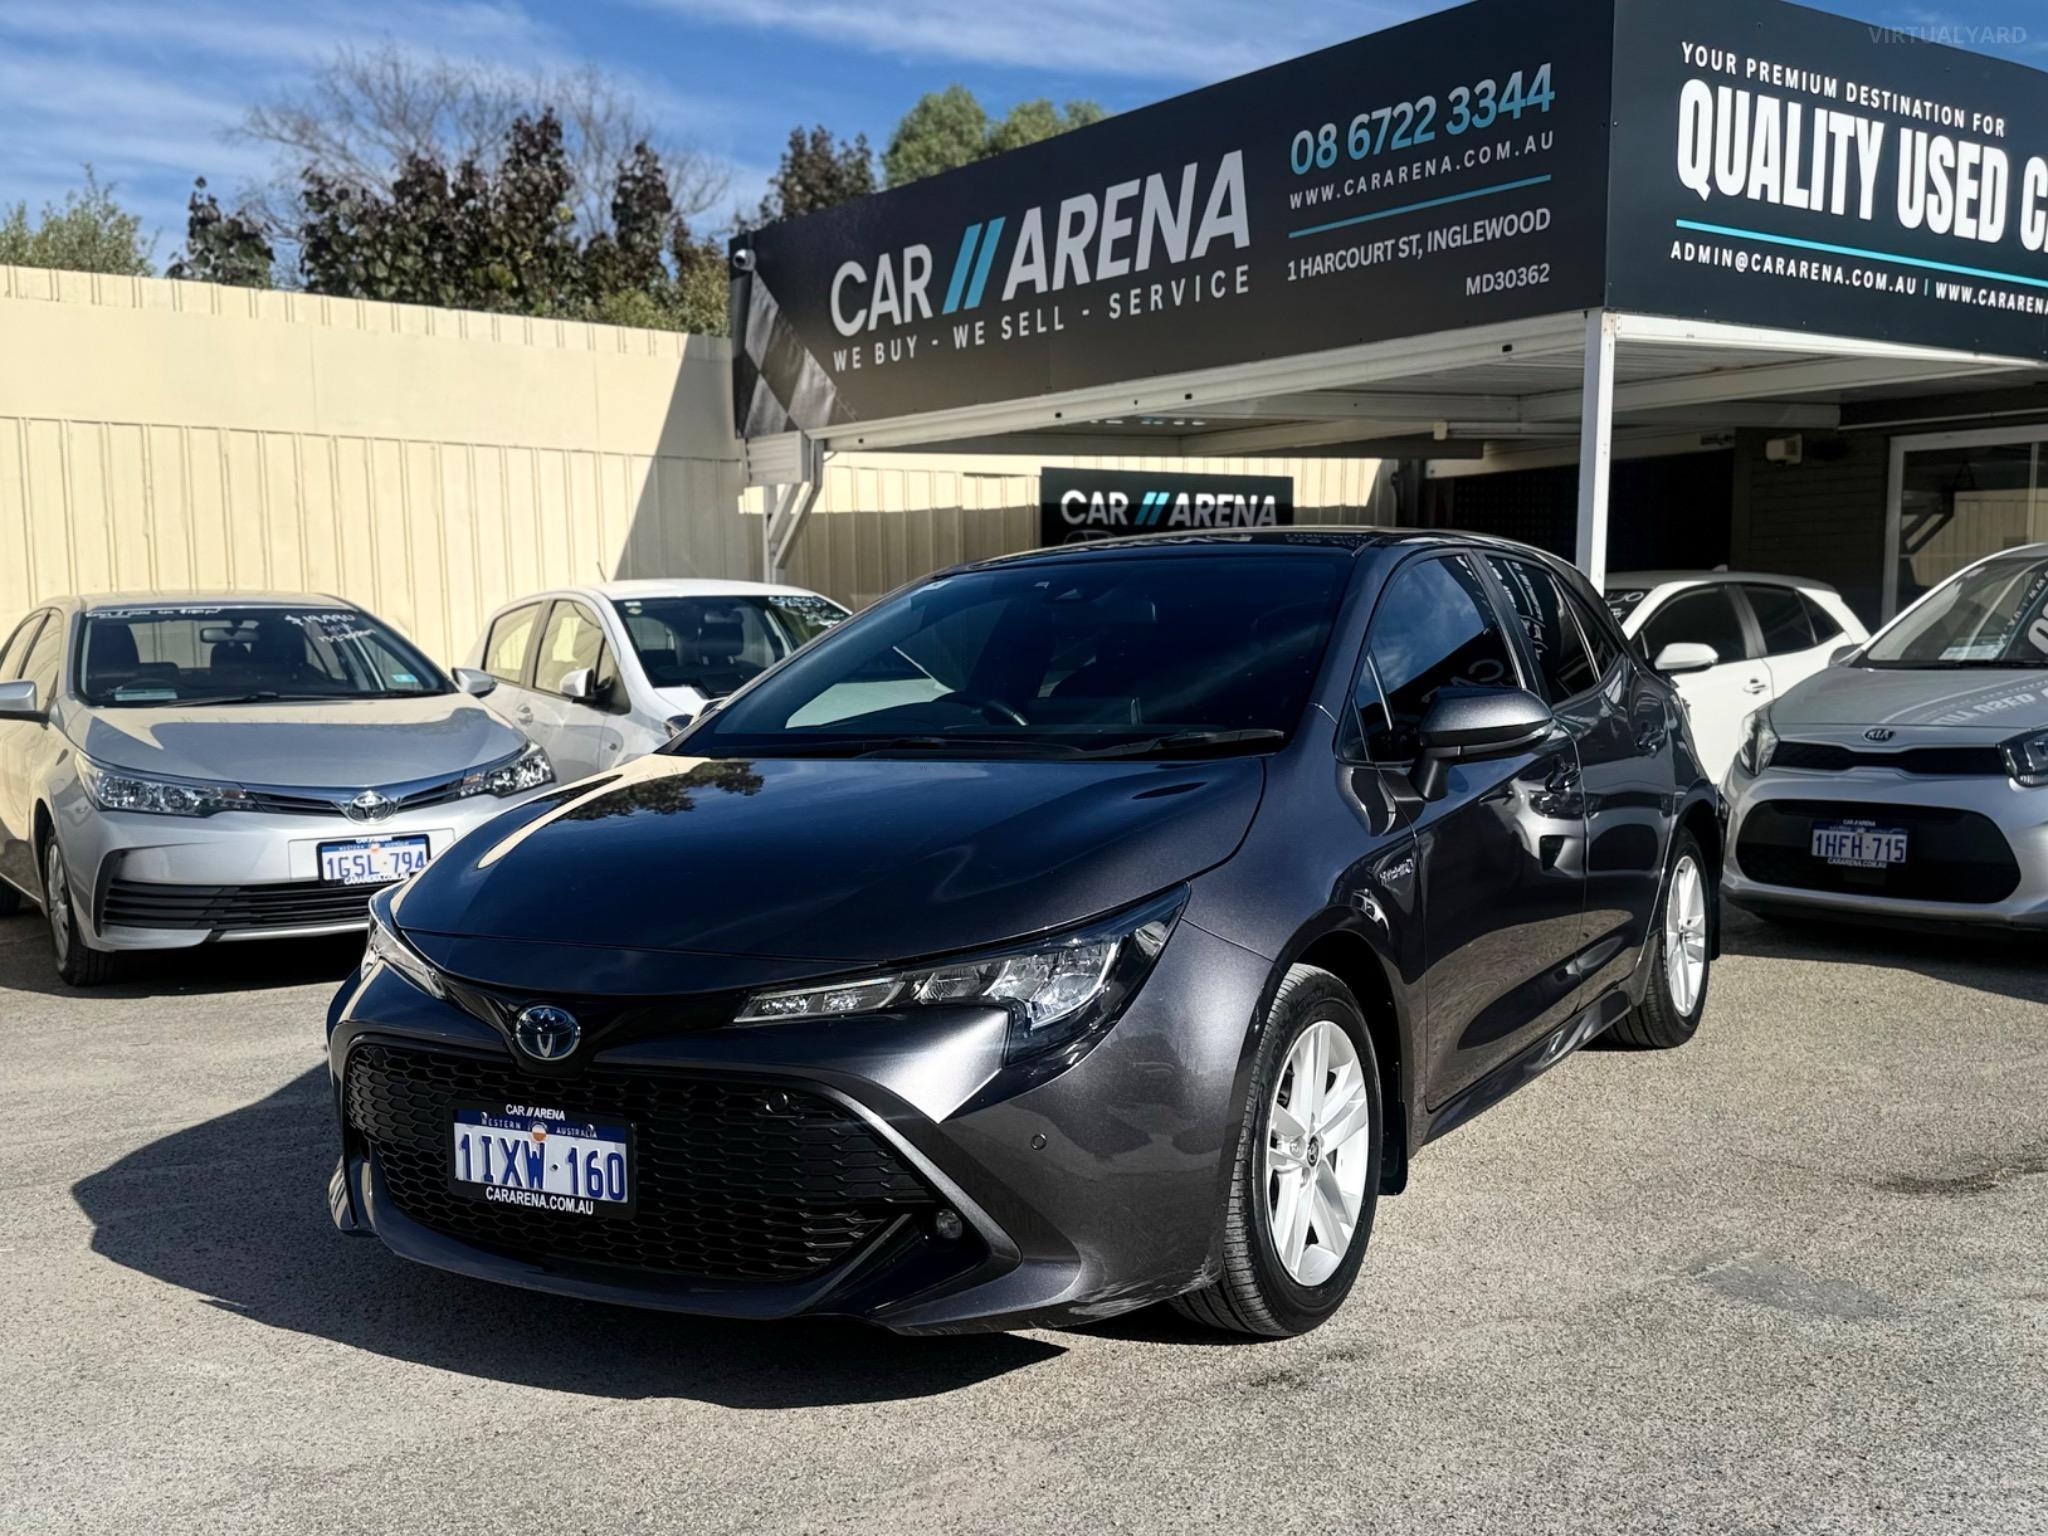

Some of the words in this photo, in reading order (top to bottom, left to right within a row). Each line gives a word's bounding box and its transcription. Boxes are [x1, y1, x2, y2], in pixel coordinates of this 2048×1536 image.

[1290, 123, 1338, 175] 08
[1347, 95, 1437, 161] 6722
[1445, 62, 1555, 135] 3344
[1682, 41, 1737, 75] YOUR
[1746, 58, 1837, 99] PREMIUM
[1846, 82, 1966, 129] DESTINATION
[1973, 112, 2006, 138] FOR
[1289, 130, 1553, 210] WWW.CARARENA.COM.AU
[1677, 78, 1885, 221] QUALITY
[1897, 127, 2009, 244] USED
[2020, 156, 2048, 254] C
[830, 243, 933, 337] CAR
[1001, 149, 1250, 302] ARENA
[1300, 239, 1395, 279] HARCOURT
[1398, 233, 1423, 260] ST,
[1427, 207, 1551, 252] INGLEWOOD
[1670, 240, 1917, 295] ADMIN@CARARENA.COM.AU
[1465, 263, 1550, 296] MD30362
[833, 346, 861, 372] WE
[875, 335, 918, 365] BUY
[953, 321, 985, 350] WE
[1001, 306, 1065, 340] SELL
[1109, 264, 1250, 320] SERVICE
[1061, 489, 1129, 525] CAR
[1168, 492, 1277, 527] ARENA
[1867, 729, 1891, 741] KIA
[506, 1104, 524, 1116] CAR
[534, 1107, 566, 1121] ARENA
[486, 1186, 594, 1215] CARARENA.COM.AU
